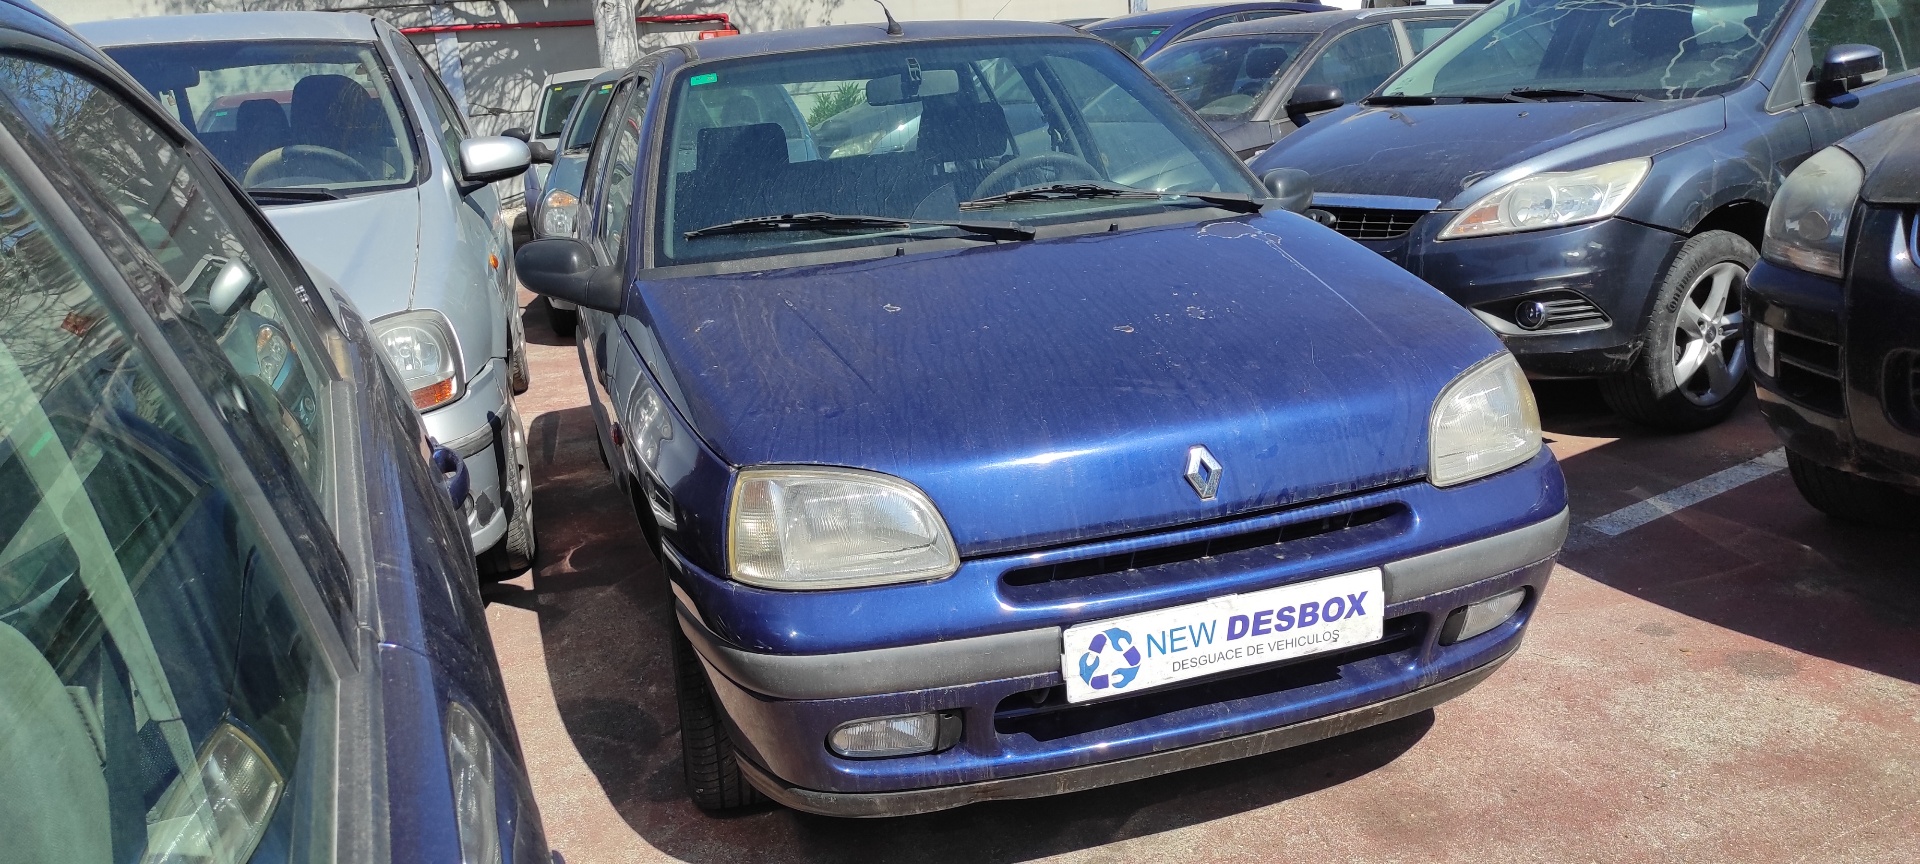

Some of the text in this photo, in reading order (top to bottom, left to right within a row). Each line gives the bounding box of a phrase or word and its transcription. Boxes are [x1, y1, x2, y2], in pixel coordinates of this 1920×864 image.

[1147, 591, 1369, 658] NEW DESBOX
[1172, 629, 1340, 672] DESGUACE DE VEHICULOS
